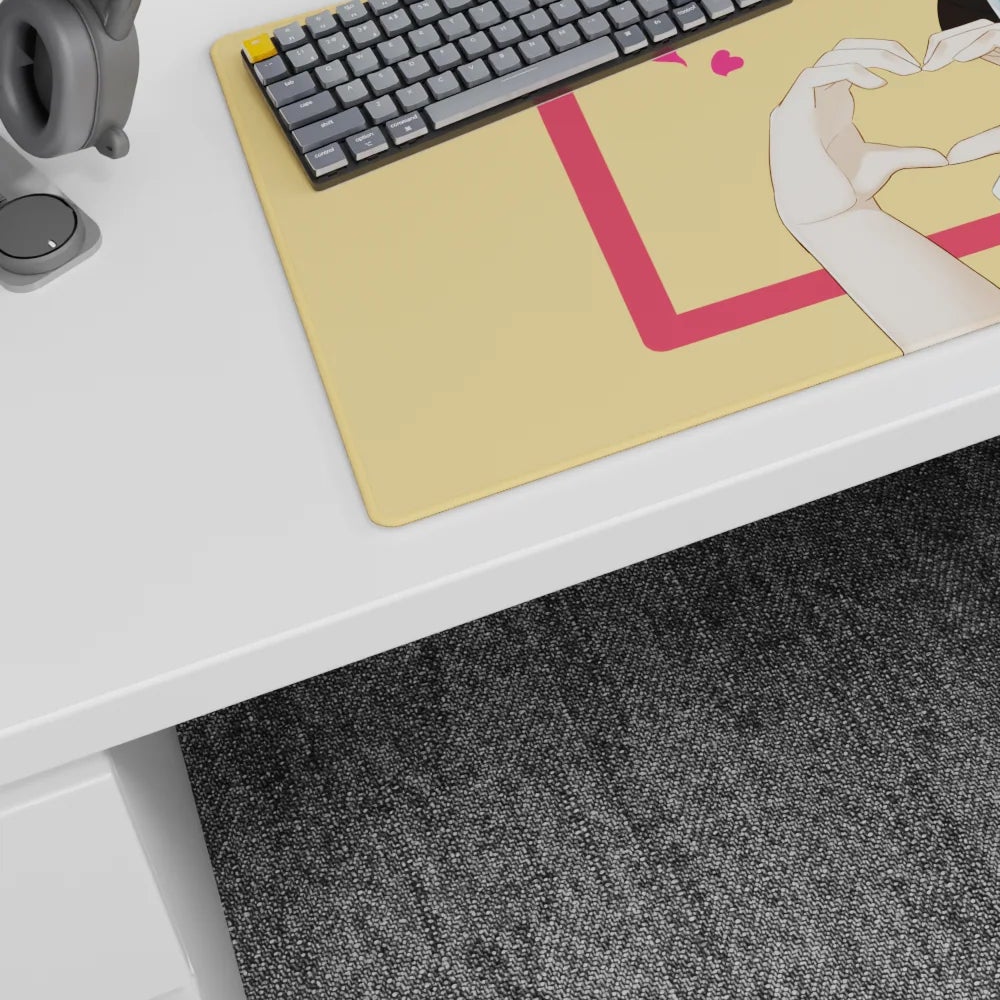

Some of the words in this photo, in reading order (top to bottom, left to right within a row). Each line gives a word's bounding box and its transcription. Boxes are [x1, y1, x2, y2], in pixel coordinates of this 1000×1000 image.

[390, 114, 418, 128] command
[355, 132, 375, 143] option
[314, 147, 335, 159] control
